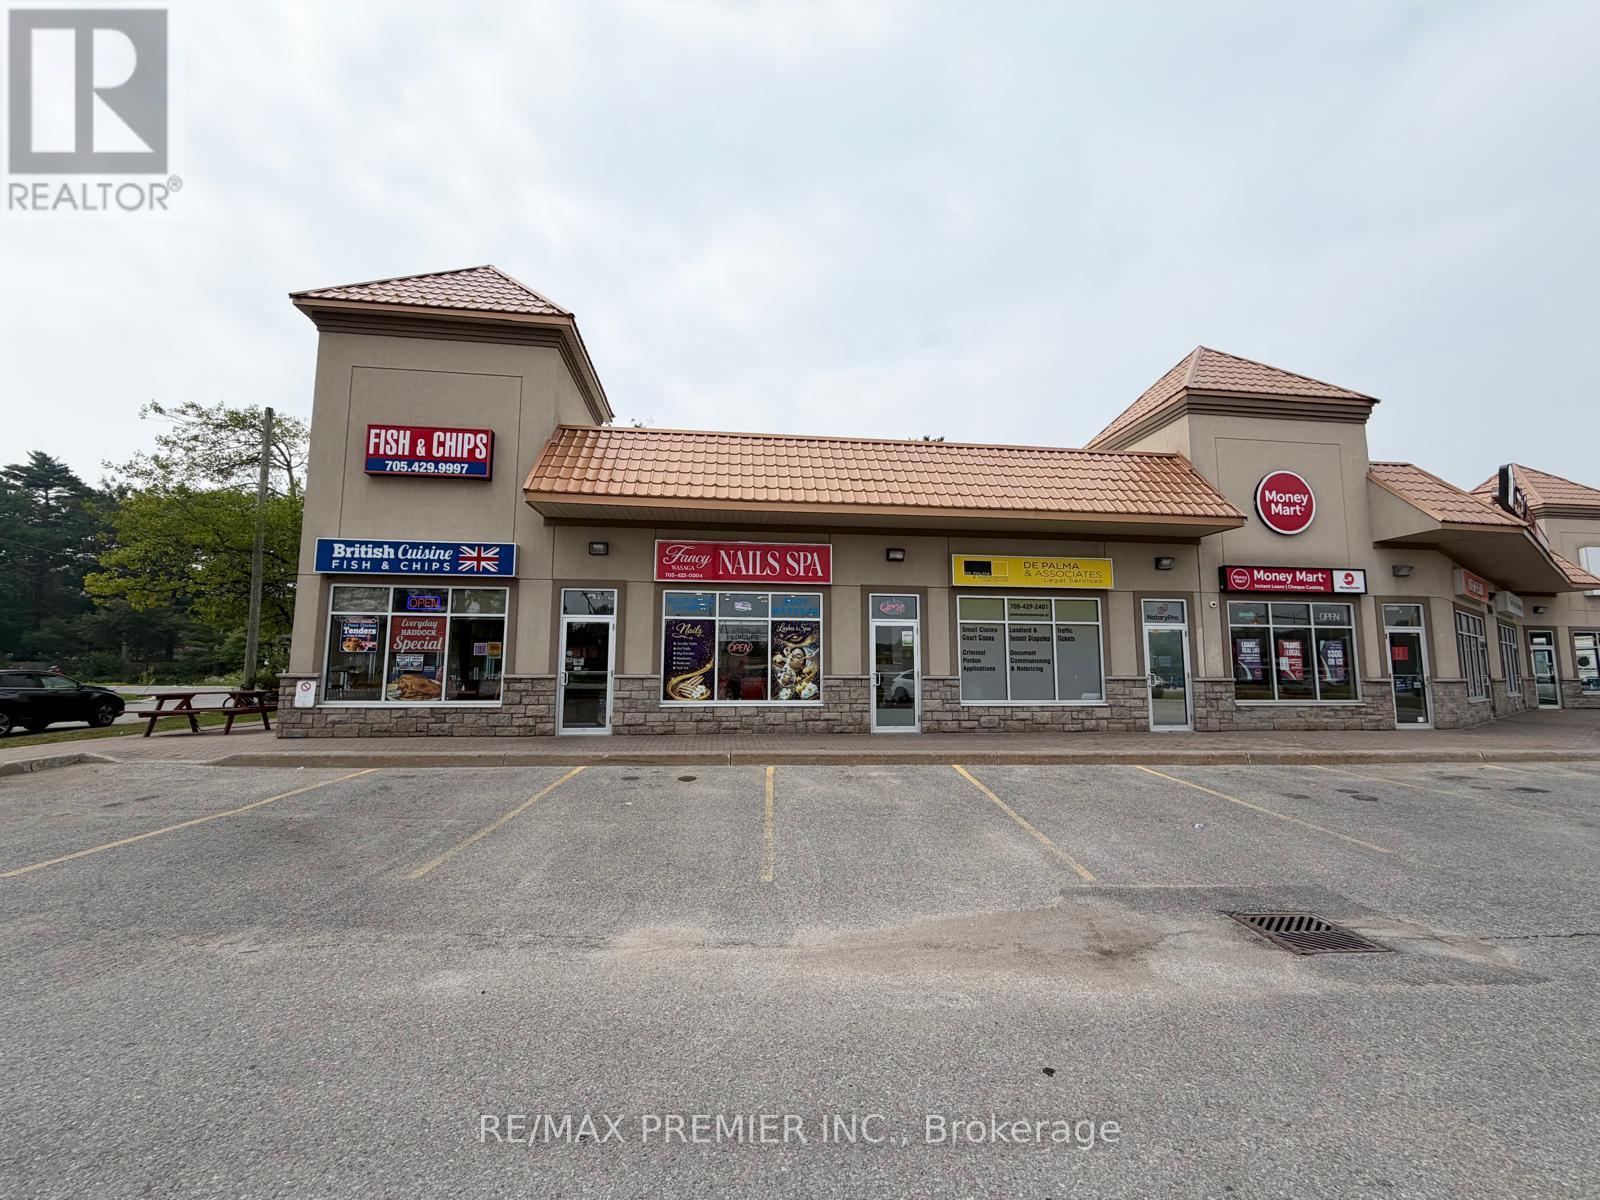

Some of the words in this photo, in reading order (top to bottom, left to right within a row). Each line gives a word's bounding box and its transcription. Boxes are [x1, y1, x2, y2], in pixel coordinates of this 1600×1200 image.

[368, 428, 411, 456] FISH
[416, 438, 426, 457] &
[432, 431, 488, 460] CHIPS
[384, 460, 469, 474] 705.429.9997
[1264, 489, 1309, 506] Money
[332, 543, 395, 559] British
[397, 544, 453, 561] Cuisine
[331, 559, 371, 570] FISH
[381, 561, 390, 570] &
[400, 561, 450, 572] CHIPS
[662, 544, 712, 569] Fancy
[718, 549, 779, 577] NAILS
[786, 551, 824, 577] SPA
[1023, 561, 1039, 570] DE
[1041, 562, 1080, 571] PALMA
[1024, 570, 1032, 578] &
[1034, 570, 1103, 580] ASSOCIATES
[1253, 569, 1293, 584] Money
[409, 597, 439, 608] OPEN
[1319, 612, 1340, 621] OPEN
[401, 618, 438, 629] Everyday
[799, 623, 812, 633] Spa
[343, 626, 377, 635] Tenders
[675, 622, 705, 638] Nails
[393, 635, 443, 653] Special
[1028, 635, 1051, 643] Disputes
[729, 643, 751, 653] OPEN
[1283, 641, 1300, 649] TRAVEL
[1010, 657, 1051, 665] Commissioning
[962, 665, 996, 673] Applications
